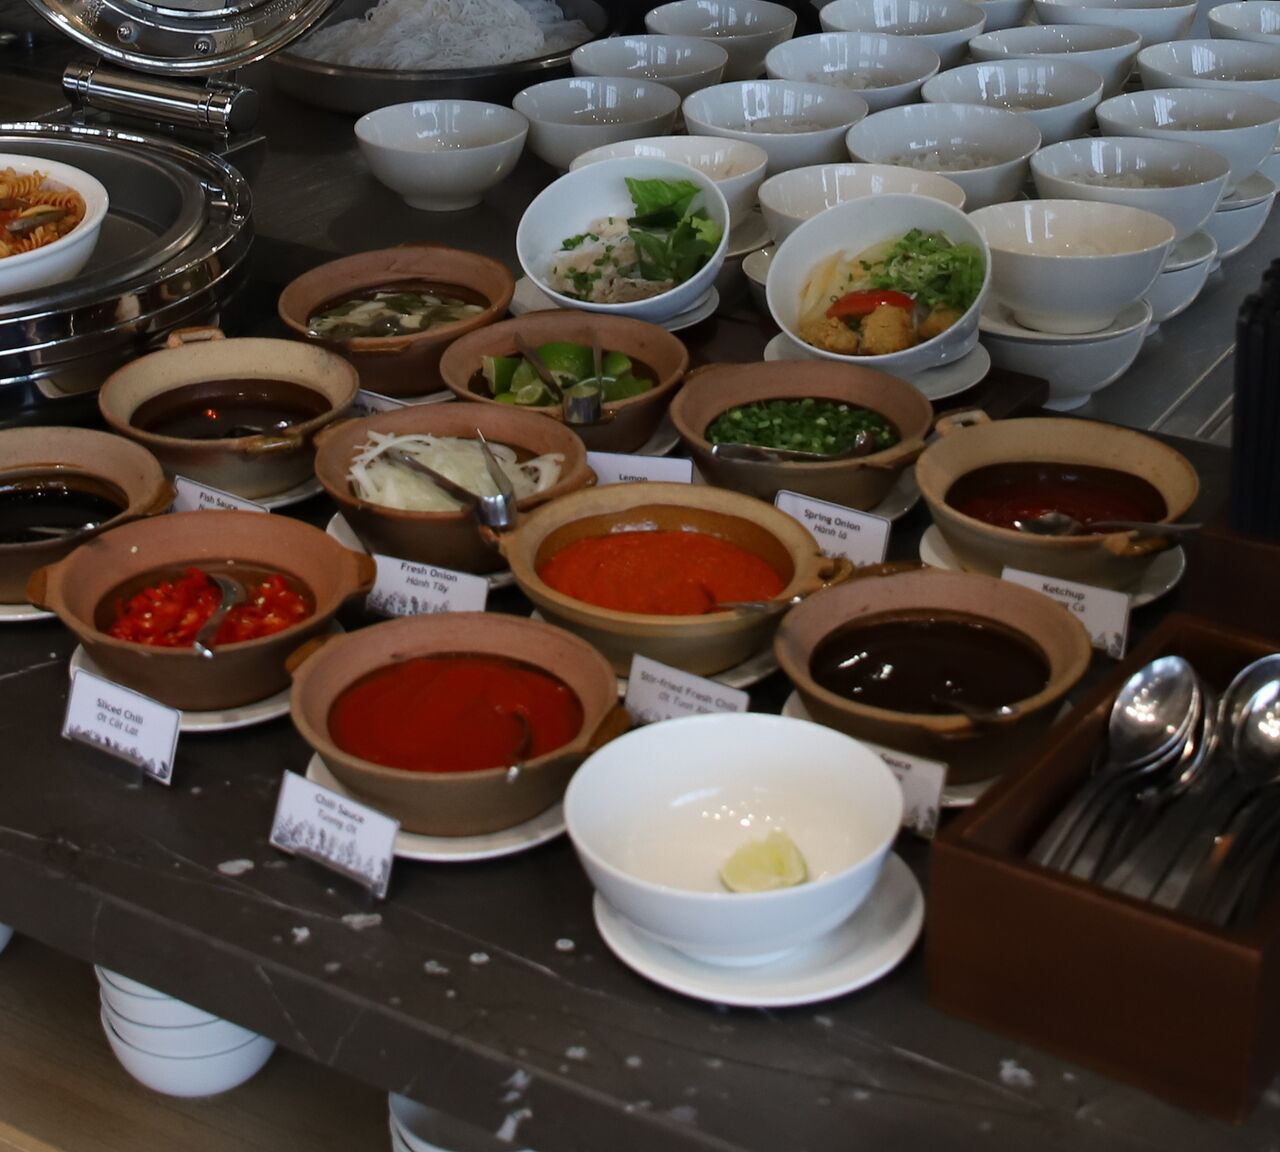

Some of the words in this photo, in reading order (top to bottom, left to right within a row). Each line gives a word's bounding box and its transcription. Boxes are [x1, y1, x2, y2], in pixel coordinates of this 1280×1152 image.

[199, 492, 215, 504] Fish
[804, 508, 832, 525] Spring
[834, 516, 861, 531] Onion
[400, 562, 427, 575] Fresh
[430, 568, 458, 583] Onion
[1042, 582, 1086, 601] Ketchup
[684, 686, 713, 705] Fresh
[97, 698, 122, 716] Sliced
[338, 803, 365, 824] Sauce
